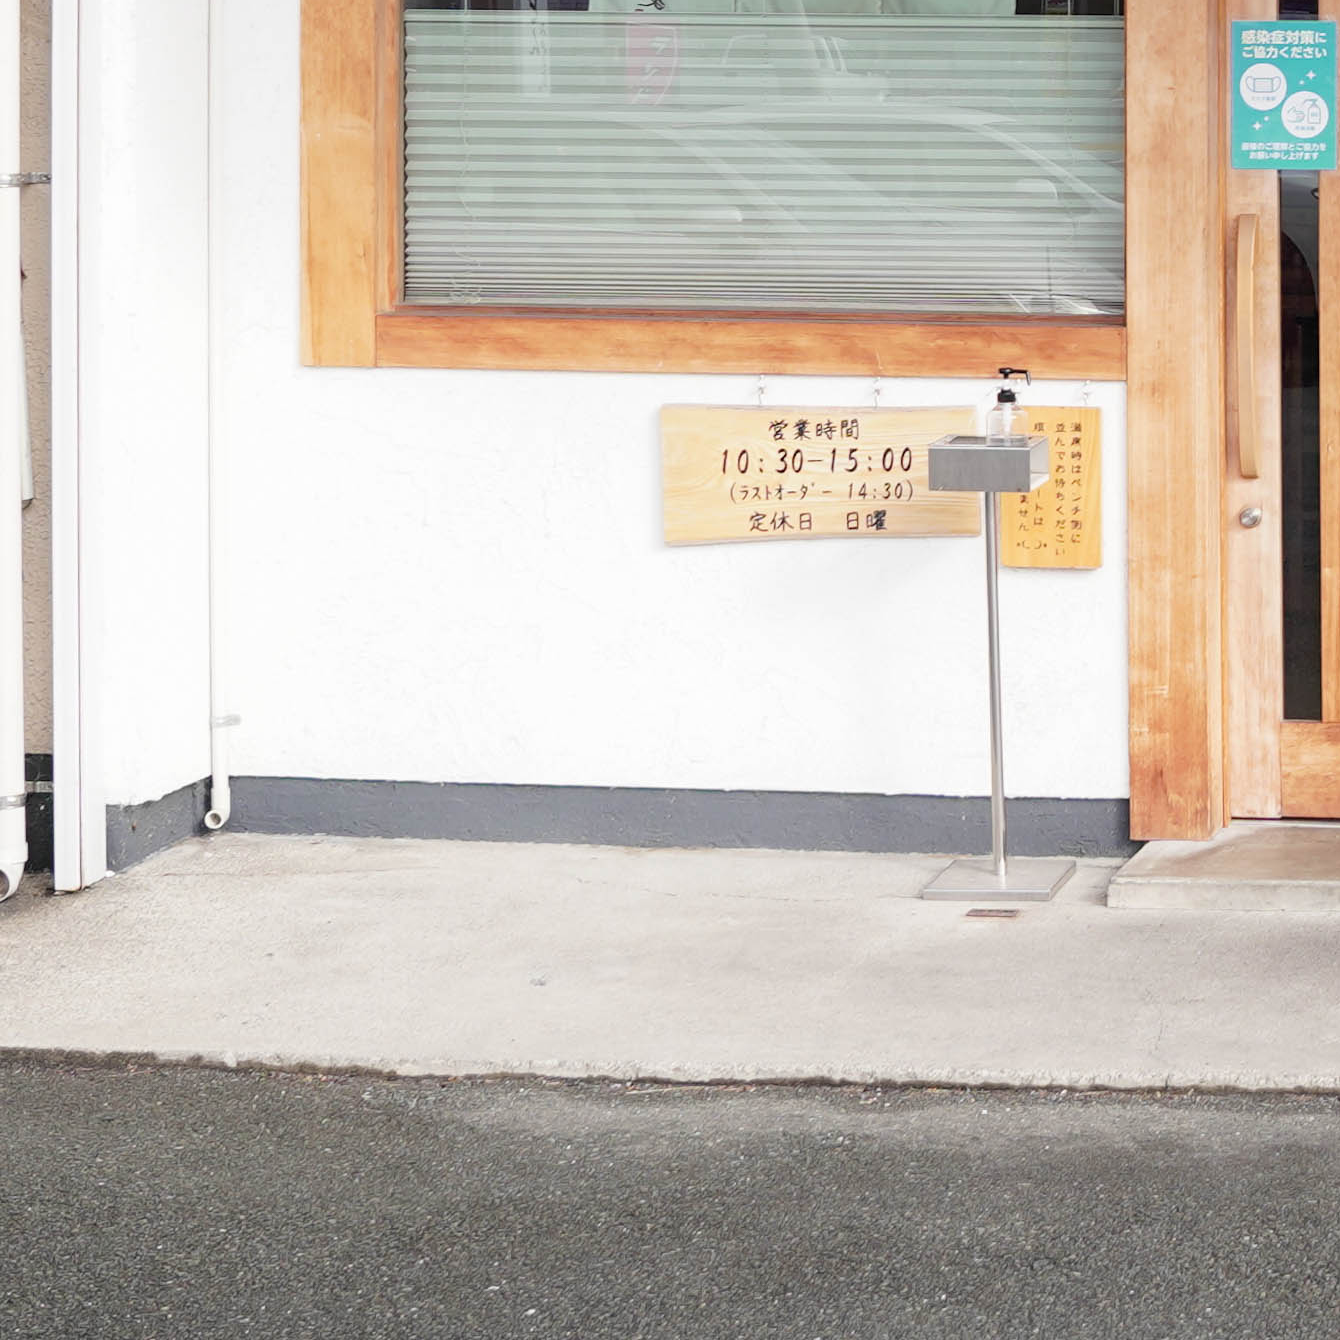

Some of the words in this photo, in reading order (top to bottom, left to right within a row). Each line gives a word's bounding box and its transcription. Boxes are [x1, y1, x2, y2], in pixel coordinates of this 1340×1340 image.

[1241, 30, 1328, 45] 感染症対策に
[1241, 46, 1328, 59] ご協力ください
[768, 419, 860, 441] 営業時間
[749, 511, 813, 532] 定休日
[846, 510, 888, 531] 日曜
